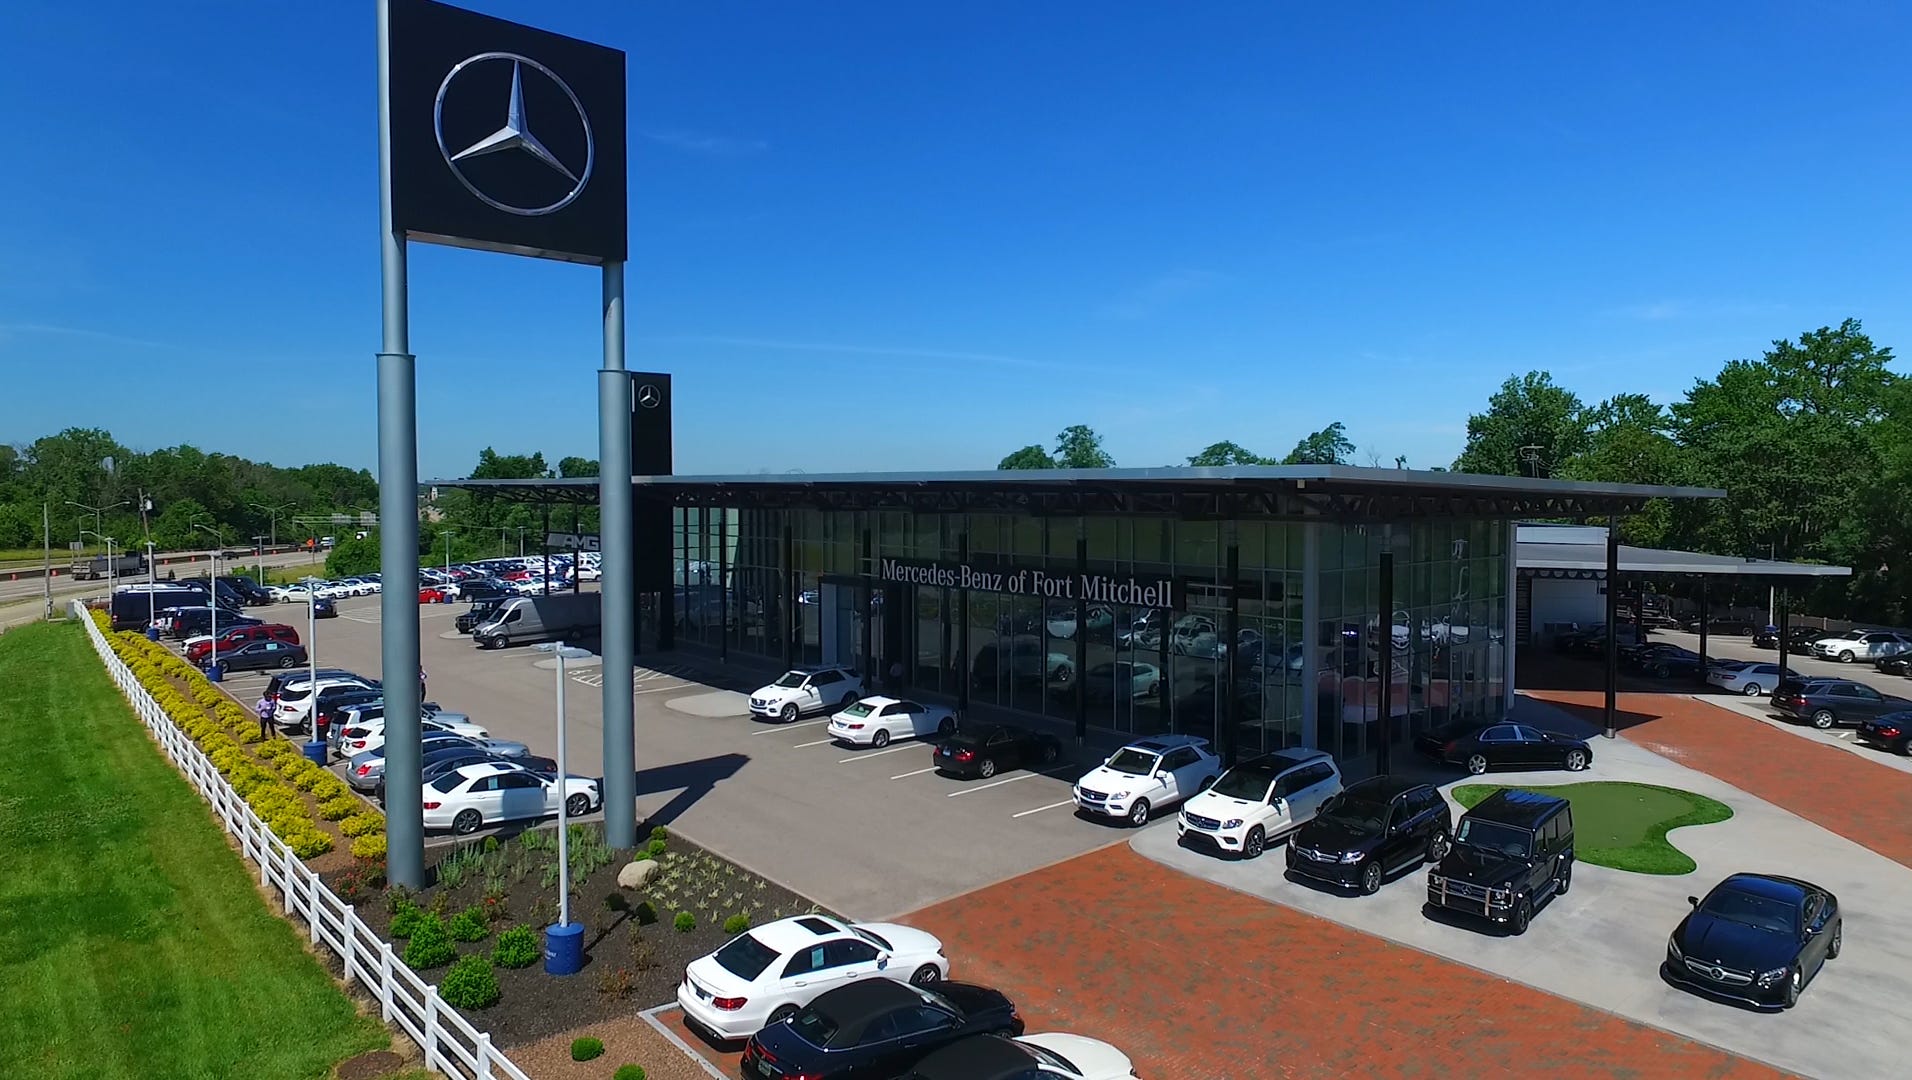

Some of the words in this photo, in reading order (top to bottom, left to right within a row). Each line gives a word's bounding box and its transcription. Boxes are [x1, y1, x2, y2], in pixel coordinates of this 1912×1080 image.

[562, 535, 600, 550] AMG
[881, 558, 1002, 591] Mercedes-Benz
[1008, 570, 1027, 593] of
[1032, 571, 1073, 598] Fort
[1080, 574, 1173, 608] Mitchell
